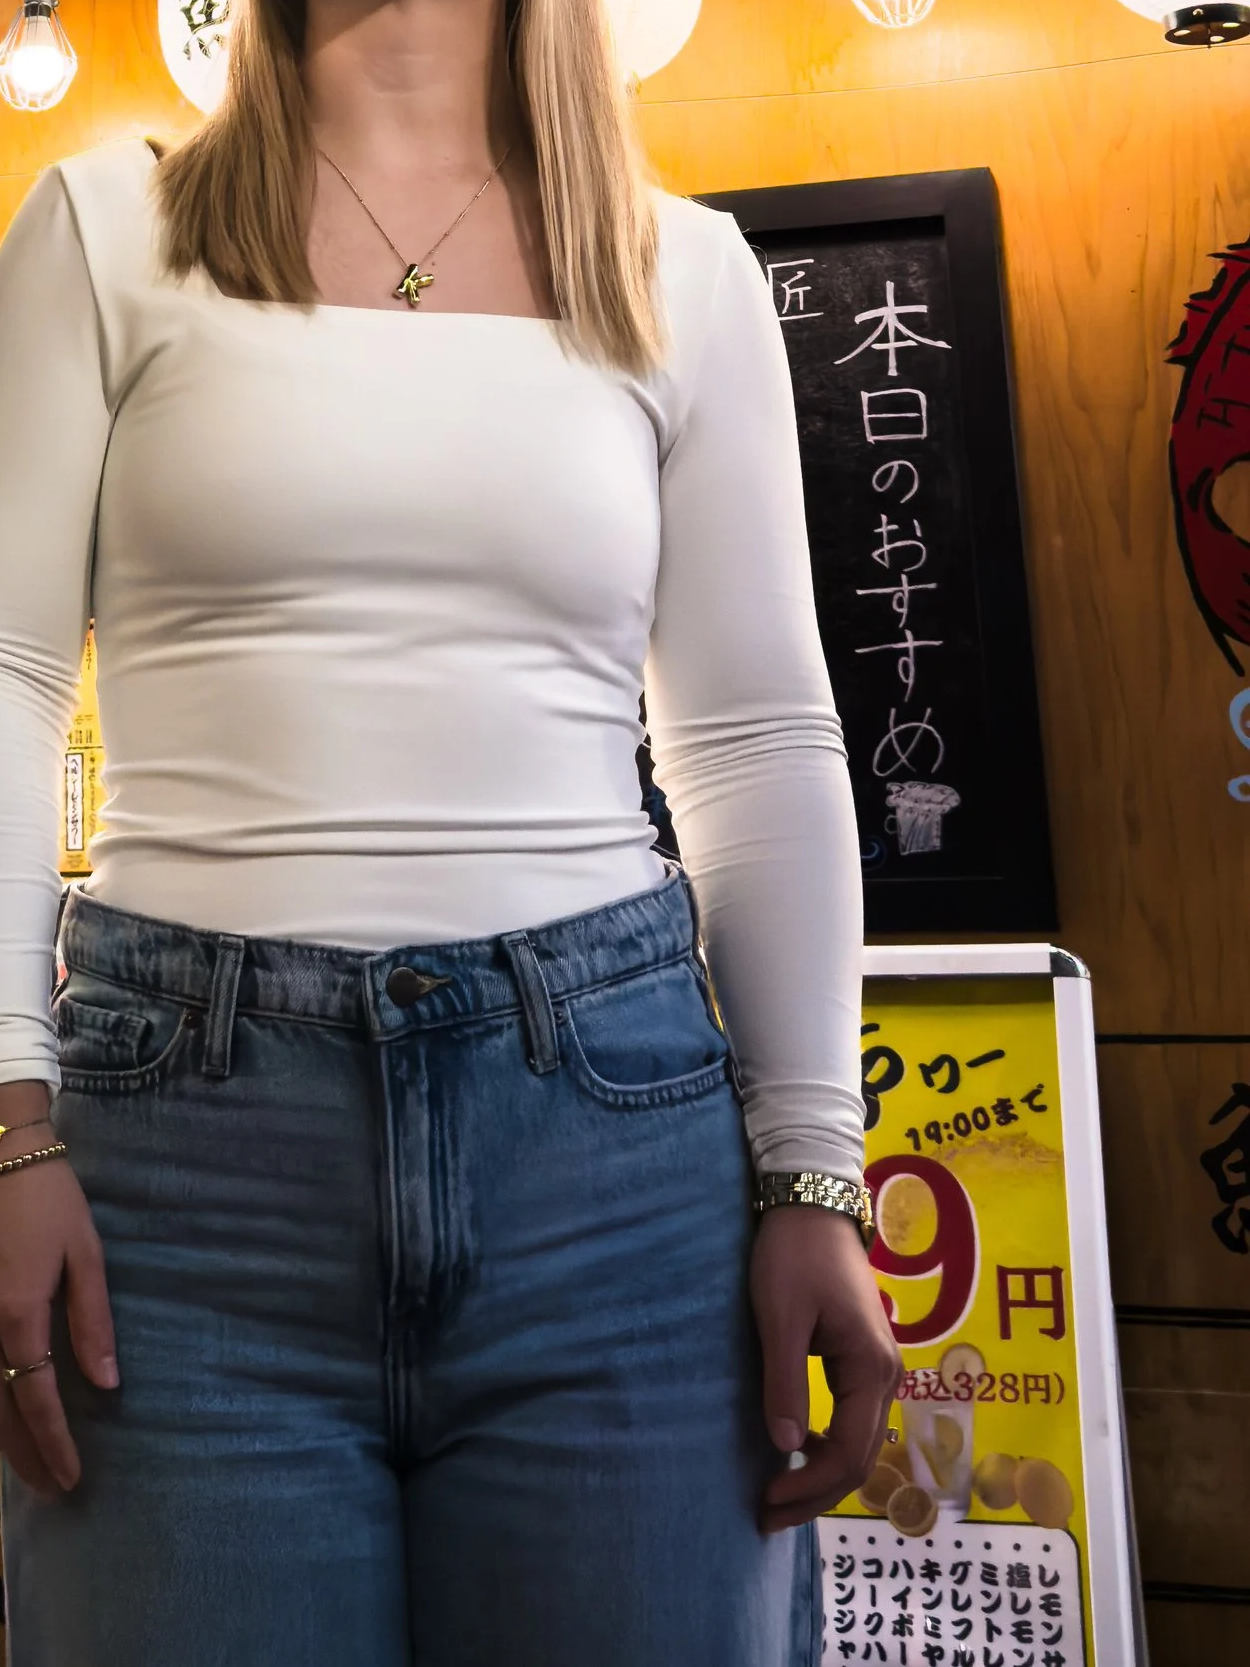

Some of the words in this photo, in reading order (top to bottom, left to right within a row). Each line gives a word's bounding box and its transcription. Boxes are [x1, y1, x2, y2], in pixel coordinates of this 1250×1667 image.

[833, 280, 952, 778] 本日のおすすめ
[904, 1083, 1049, 1152] 19:00まで
[832, 1553, 857, 1667] ジンジャ
